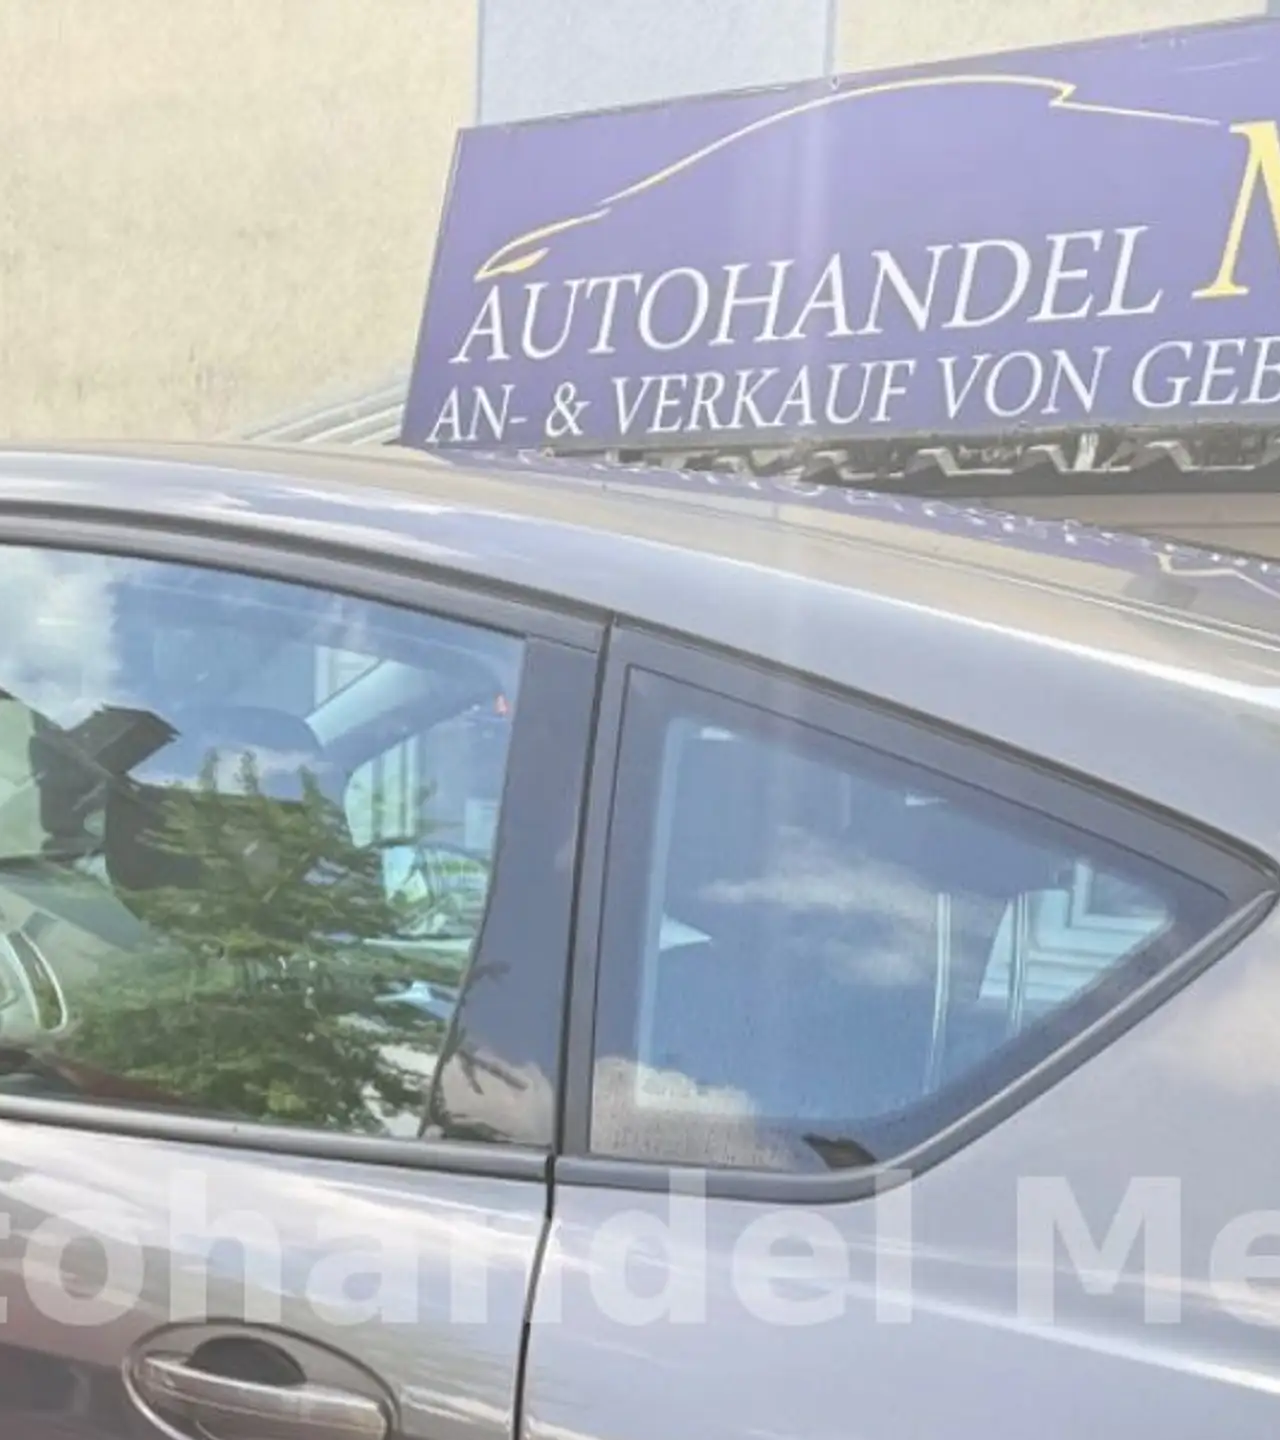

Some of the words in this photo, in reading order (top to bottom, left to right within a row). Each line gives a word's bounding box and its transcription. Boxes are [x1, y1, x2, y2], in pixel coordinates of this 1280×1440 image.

[448, 225, 1163, 364] AUTOHANDEL
[425, 384, 527, 443] AN-
[545, 382, 592, 437] &
[611, 358, 916, 436] VERKAUF
[937, 346, 1111, 419] VON
